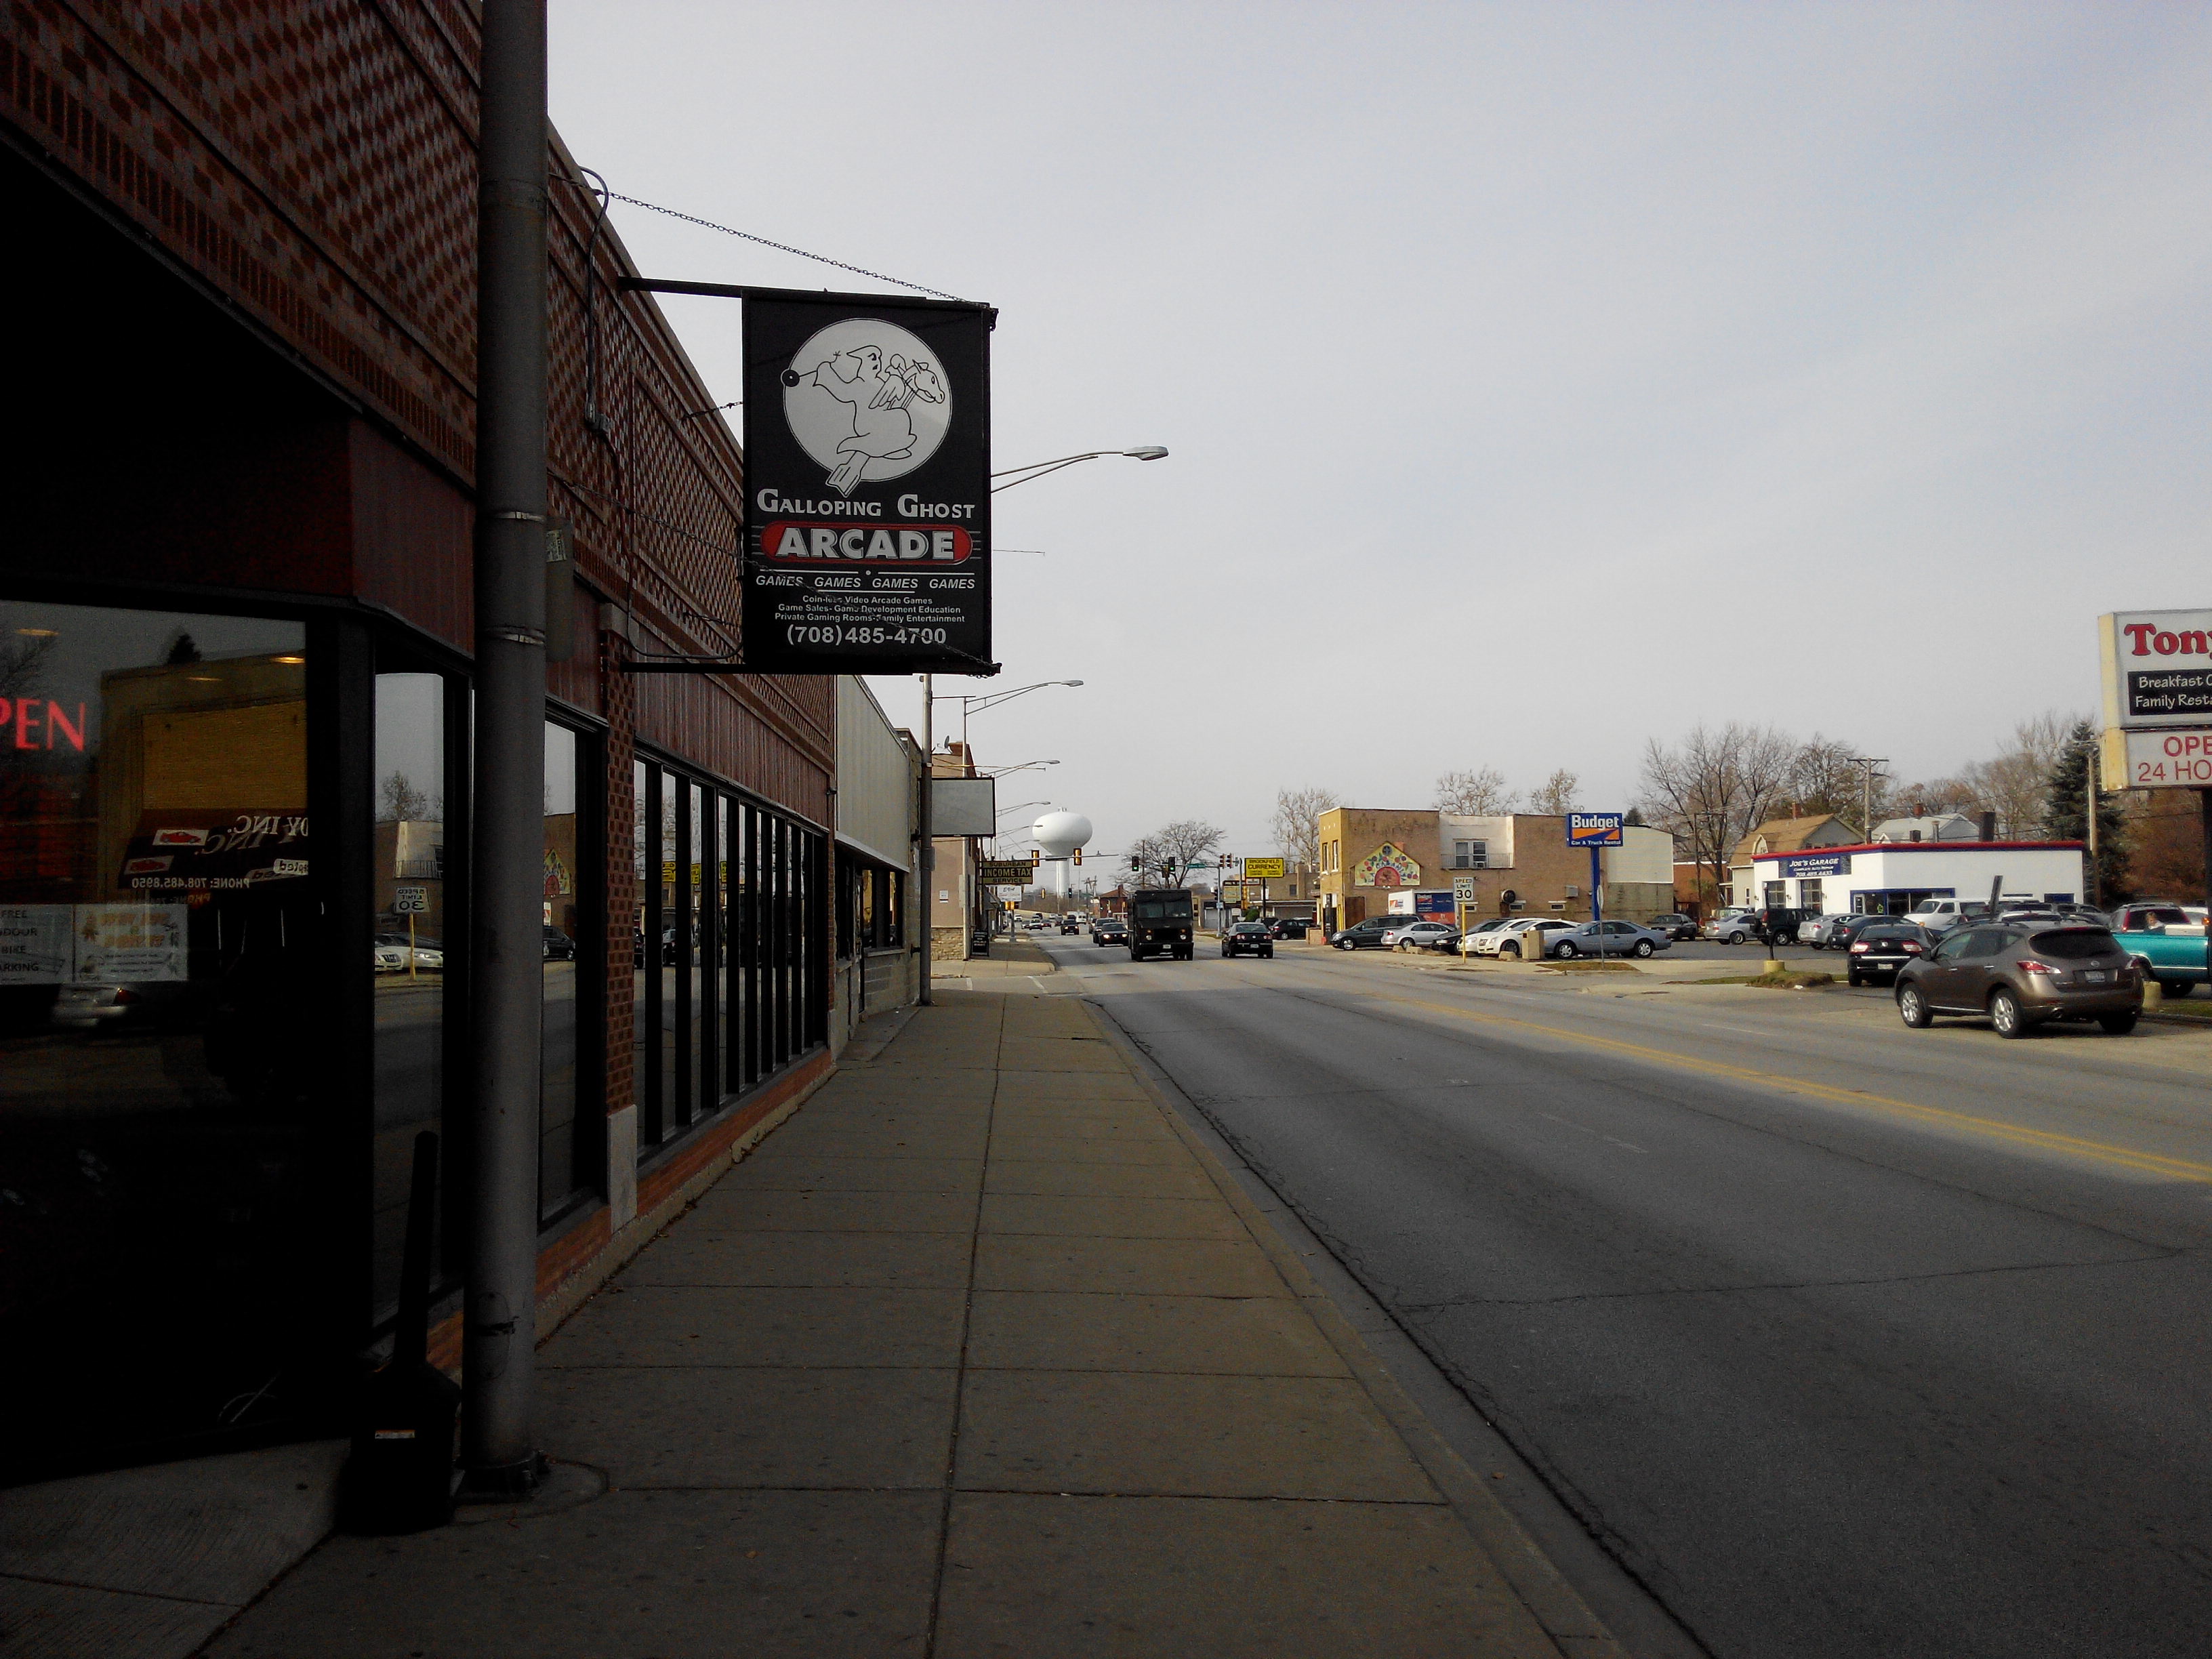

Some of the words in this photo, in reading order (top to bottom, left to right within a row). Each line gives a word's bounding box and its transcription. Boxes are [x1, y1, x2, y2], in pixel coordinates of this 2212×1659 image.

[757, 488, 882, 516] GALLOPING
[897, 493, 976, 518] GHOST
[775, 527, 955, 560] ARCADE
[756, 575, 804, 587] GAMES
[814, 577, 861, 588] GAMES
[872, 578, 919, 589] GAMES
[929, 579, 976, 590] GAMES
[903, 596, 933, 605] Games
[778, 603, 804, 611] Game
[834, 605, 859, 613] Game
[861, 605, 916, 614] Development
[918, 605, 961, 613] Education
[775, 613, 805, 621] Private
[807, 613, 840, 623] Gaming
[906, 614, 966, 622] Entertainment
[2139, 674, 2204, 689] Breakfast
[2135, 694, 2175, 710] Family
[2137, 762, 2167, 781] 24
[2175, 759, 2212, 781] HO
[1572, 815, 1620, 831] Budget
[1789, 859, 1809, 867] JOE'S
[1809, 858, 1839, 866] GARAGE
[984, 868, 1015, 877] INCOME
[1017, 868, 1031, 877] TAX
[1456, 889, 1472, 899] 30
[1, 909, 28, 918] FREE
